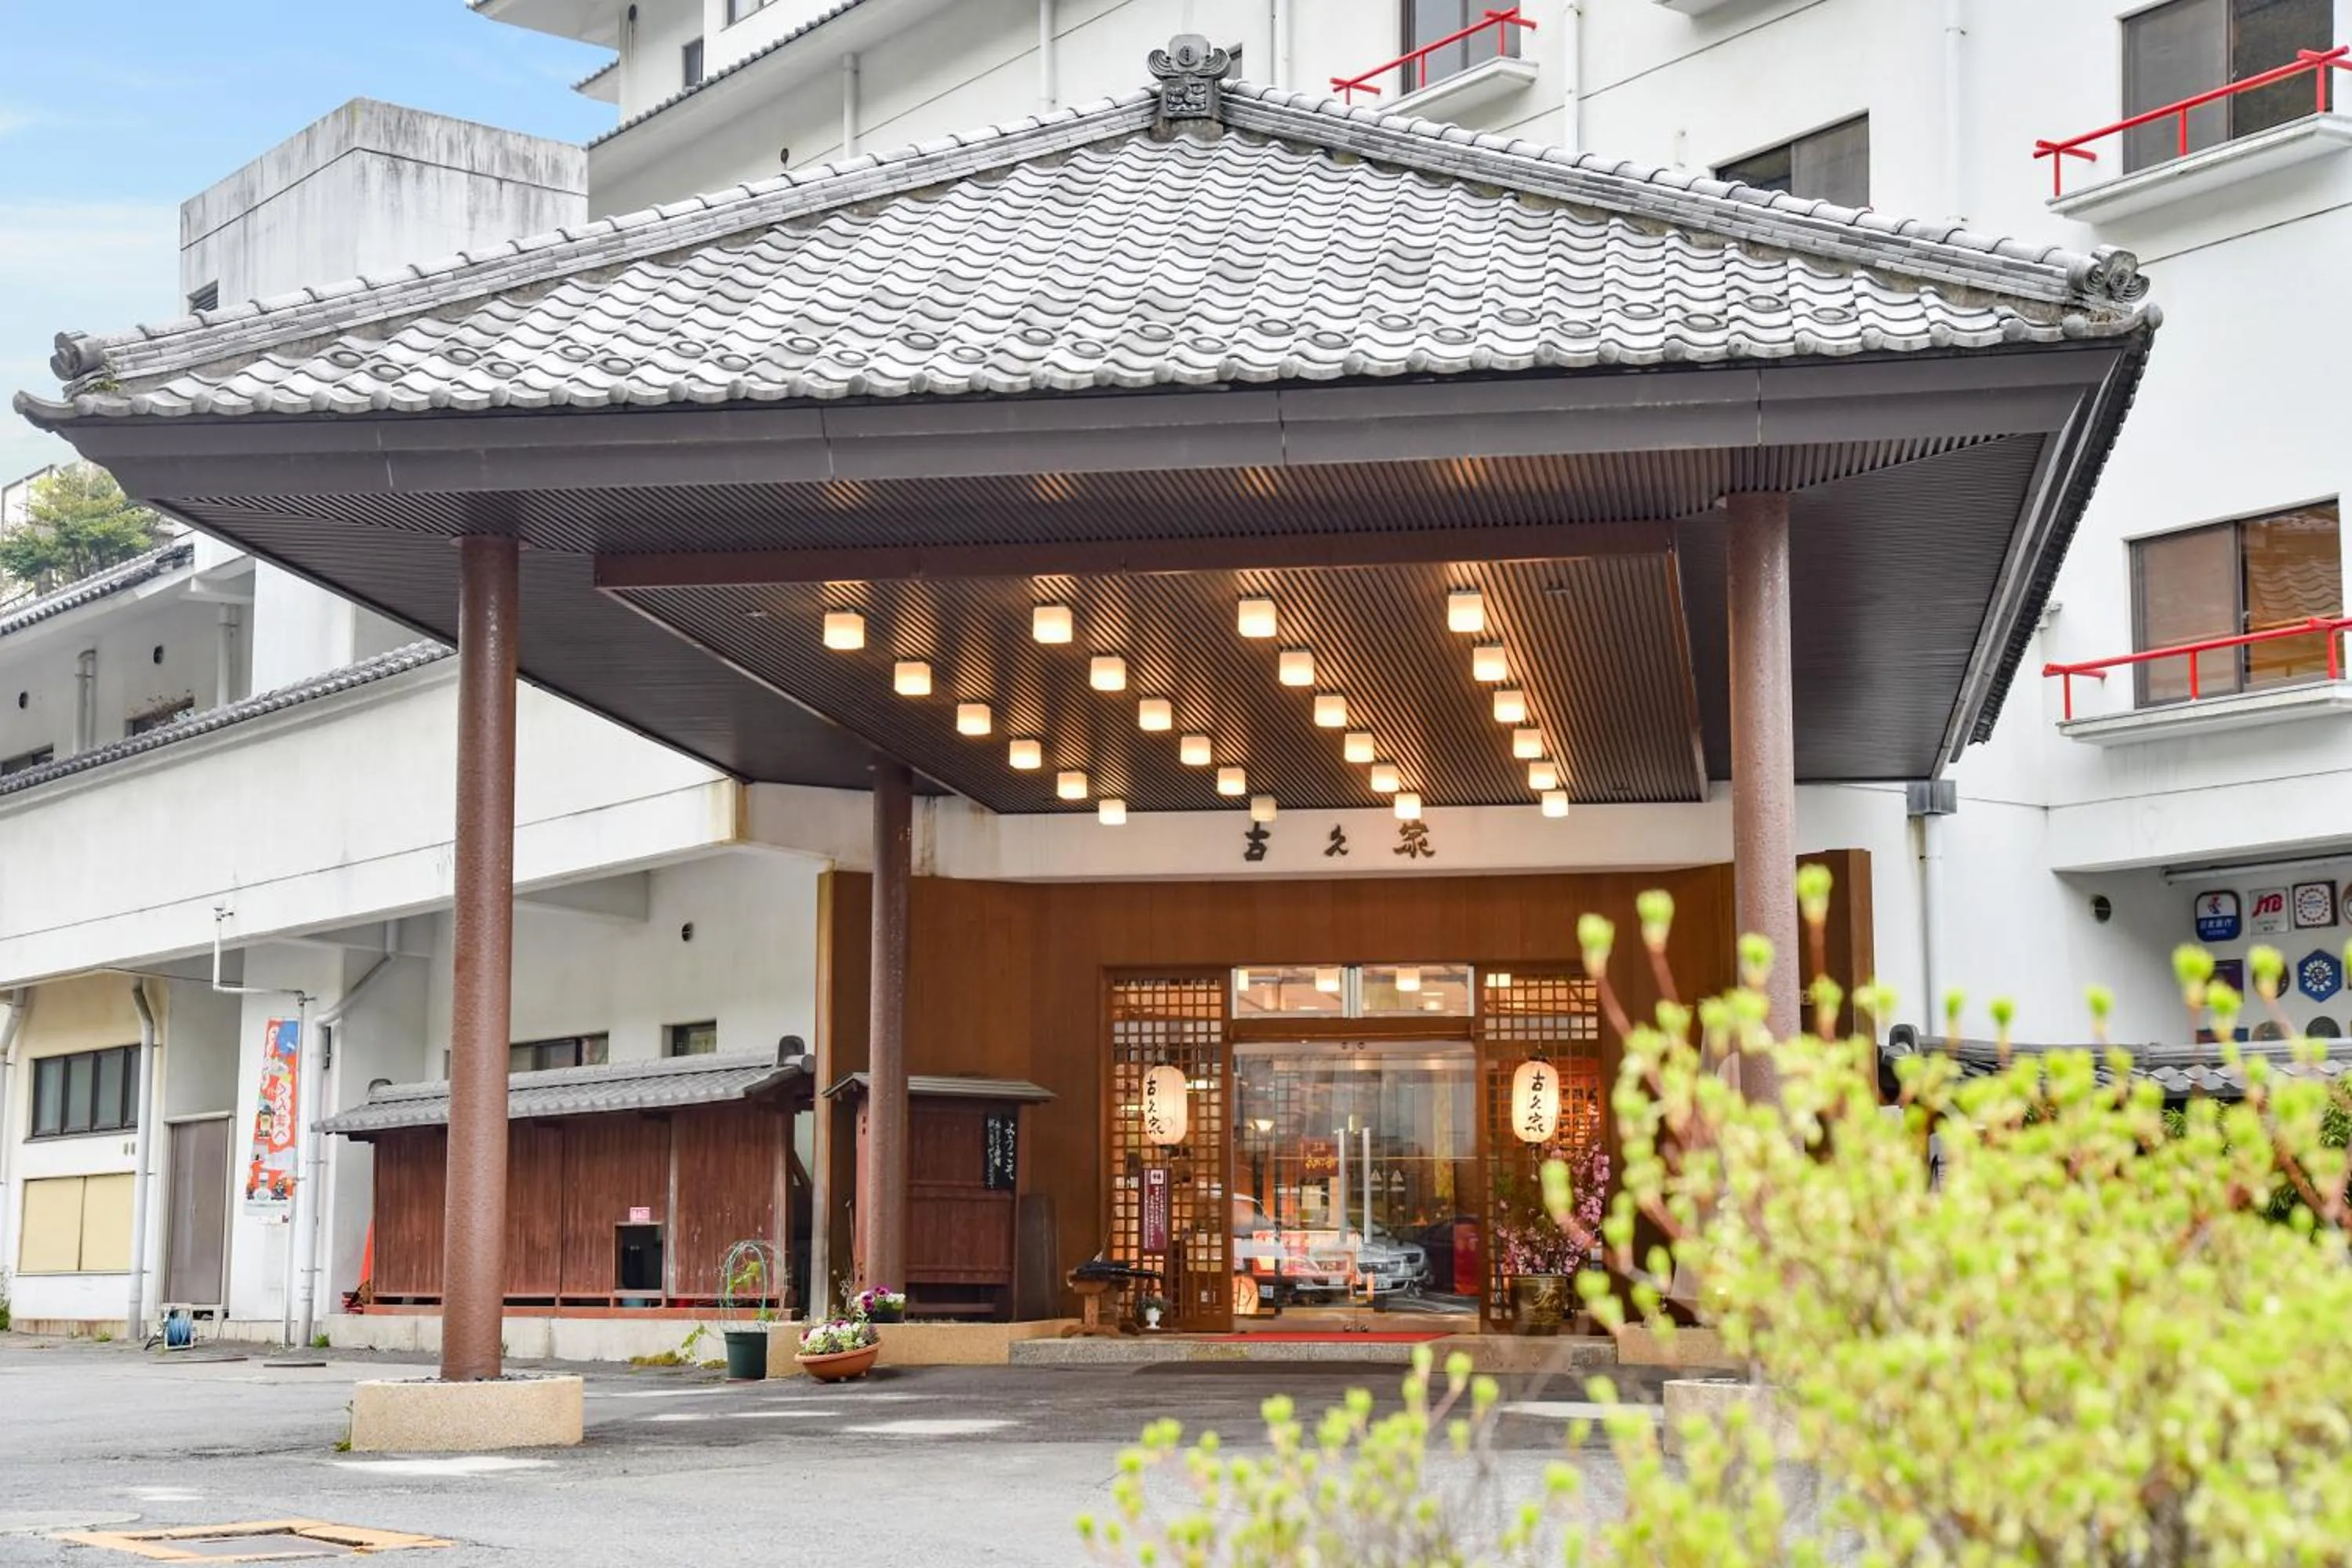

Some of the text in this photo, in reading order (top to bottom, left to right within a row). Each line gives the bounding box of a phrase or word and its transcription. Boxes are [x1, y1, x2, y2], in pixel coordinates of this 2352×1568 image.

[1243, 820, 1436, 862] 古久家
[2252, 893, 2283, 918] JTB
[1147, 1076, 1165, 1135] 古久家
[1524, 1069, 1545, 1133] 古久家
